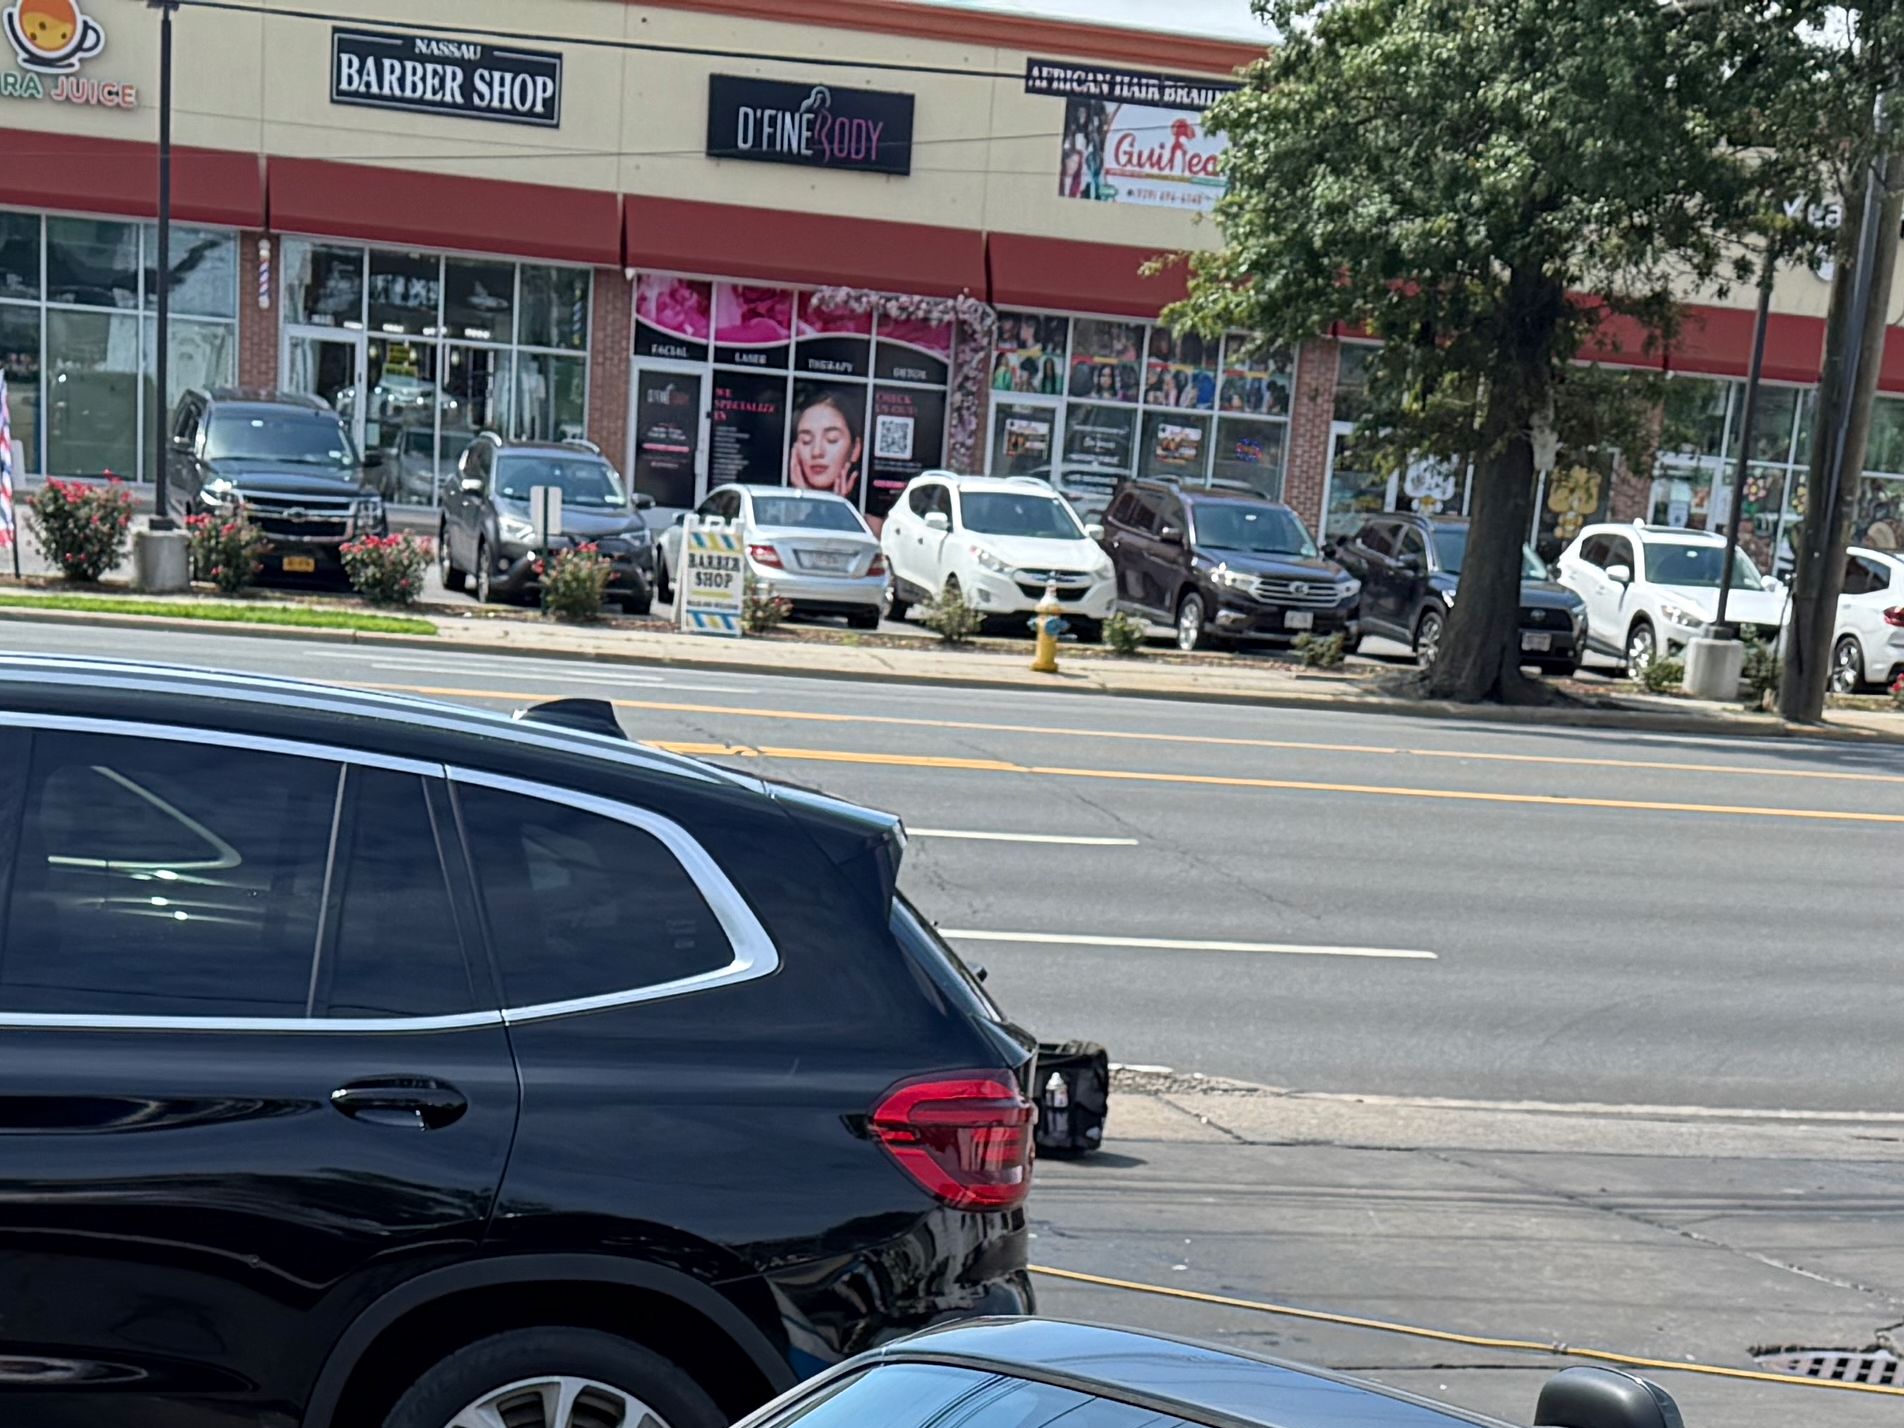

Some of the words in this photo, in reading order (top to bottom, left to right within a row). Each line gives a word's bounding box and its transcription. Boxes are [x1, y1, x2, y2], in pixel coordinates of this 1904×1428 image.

[414, 38, 482, 61] NASSAU
[51, 75, 138, 108] JUICE
[338, 53, 465, 105] BARBER
[472, 68, 555, 113] SHOP
[1028, 66, 1112, 97] AFRICAN
[1114, 75, 1161, 100] HAIR
[695, 571, 734, 589] SHOP
